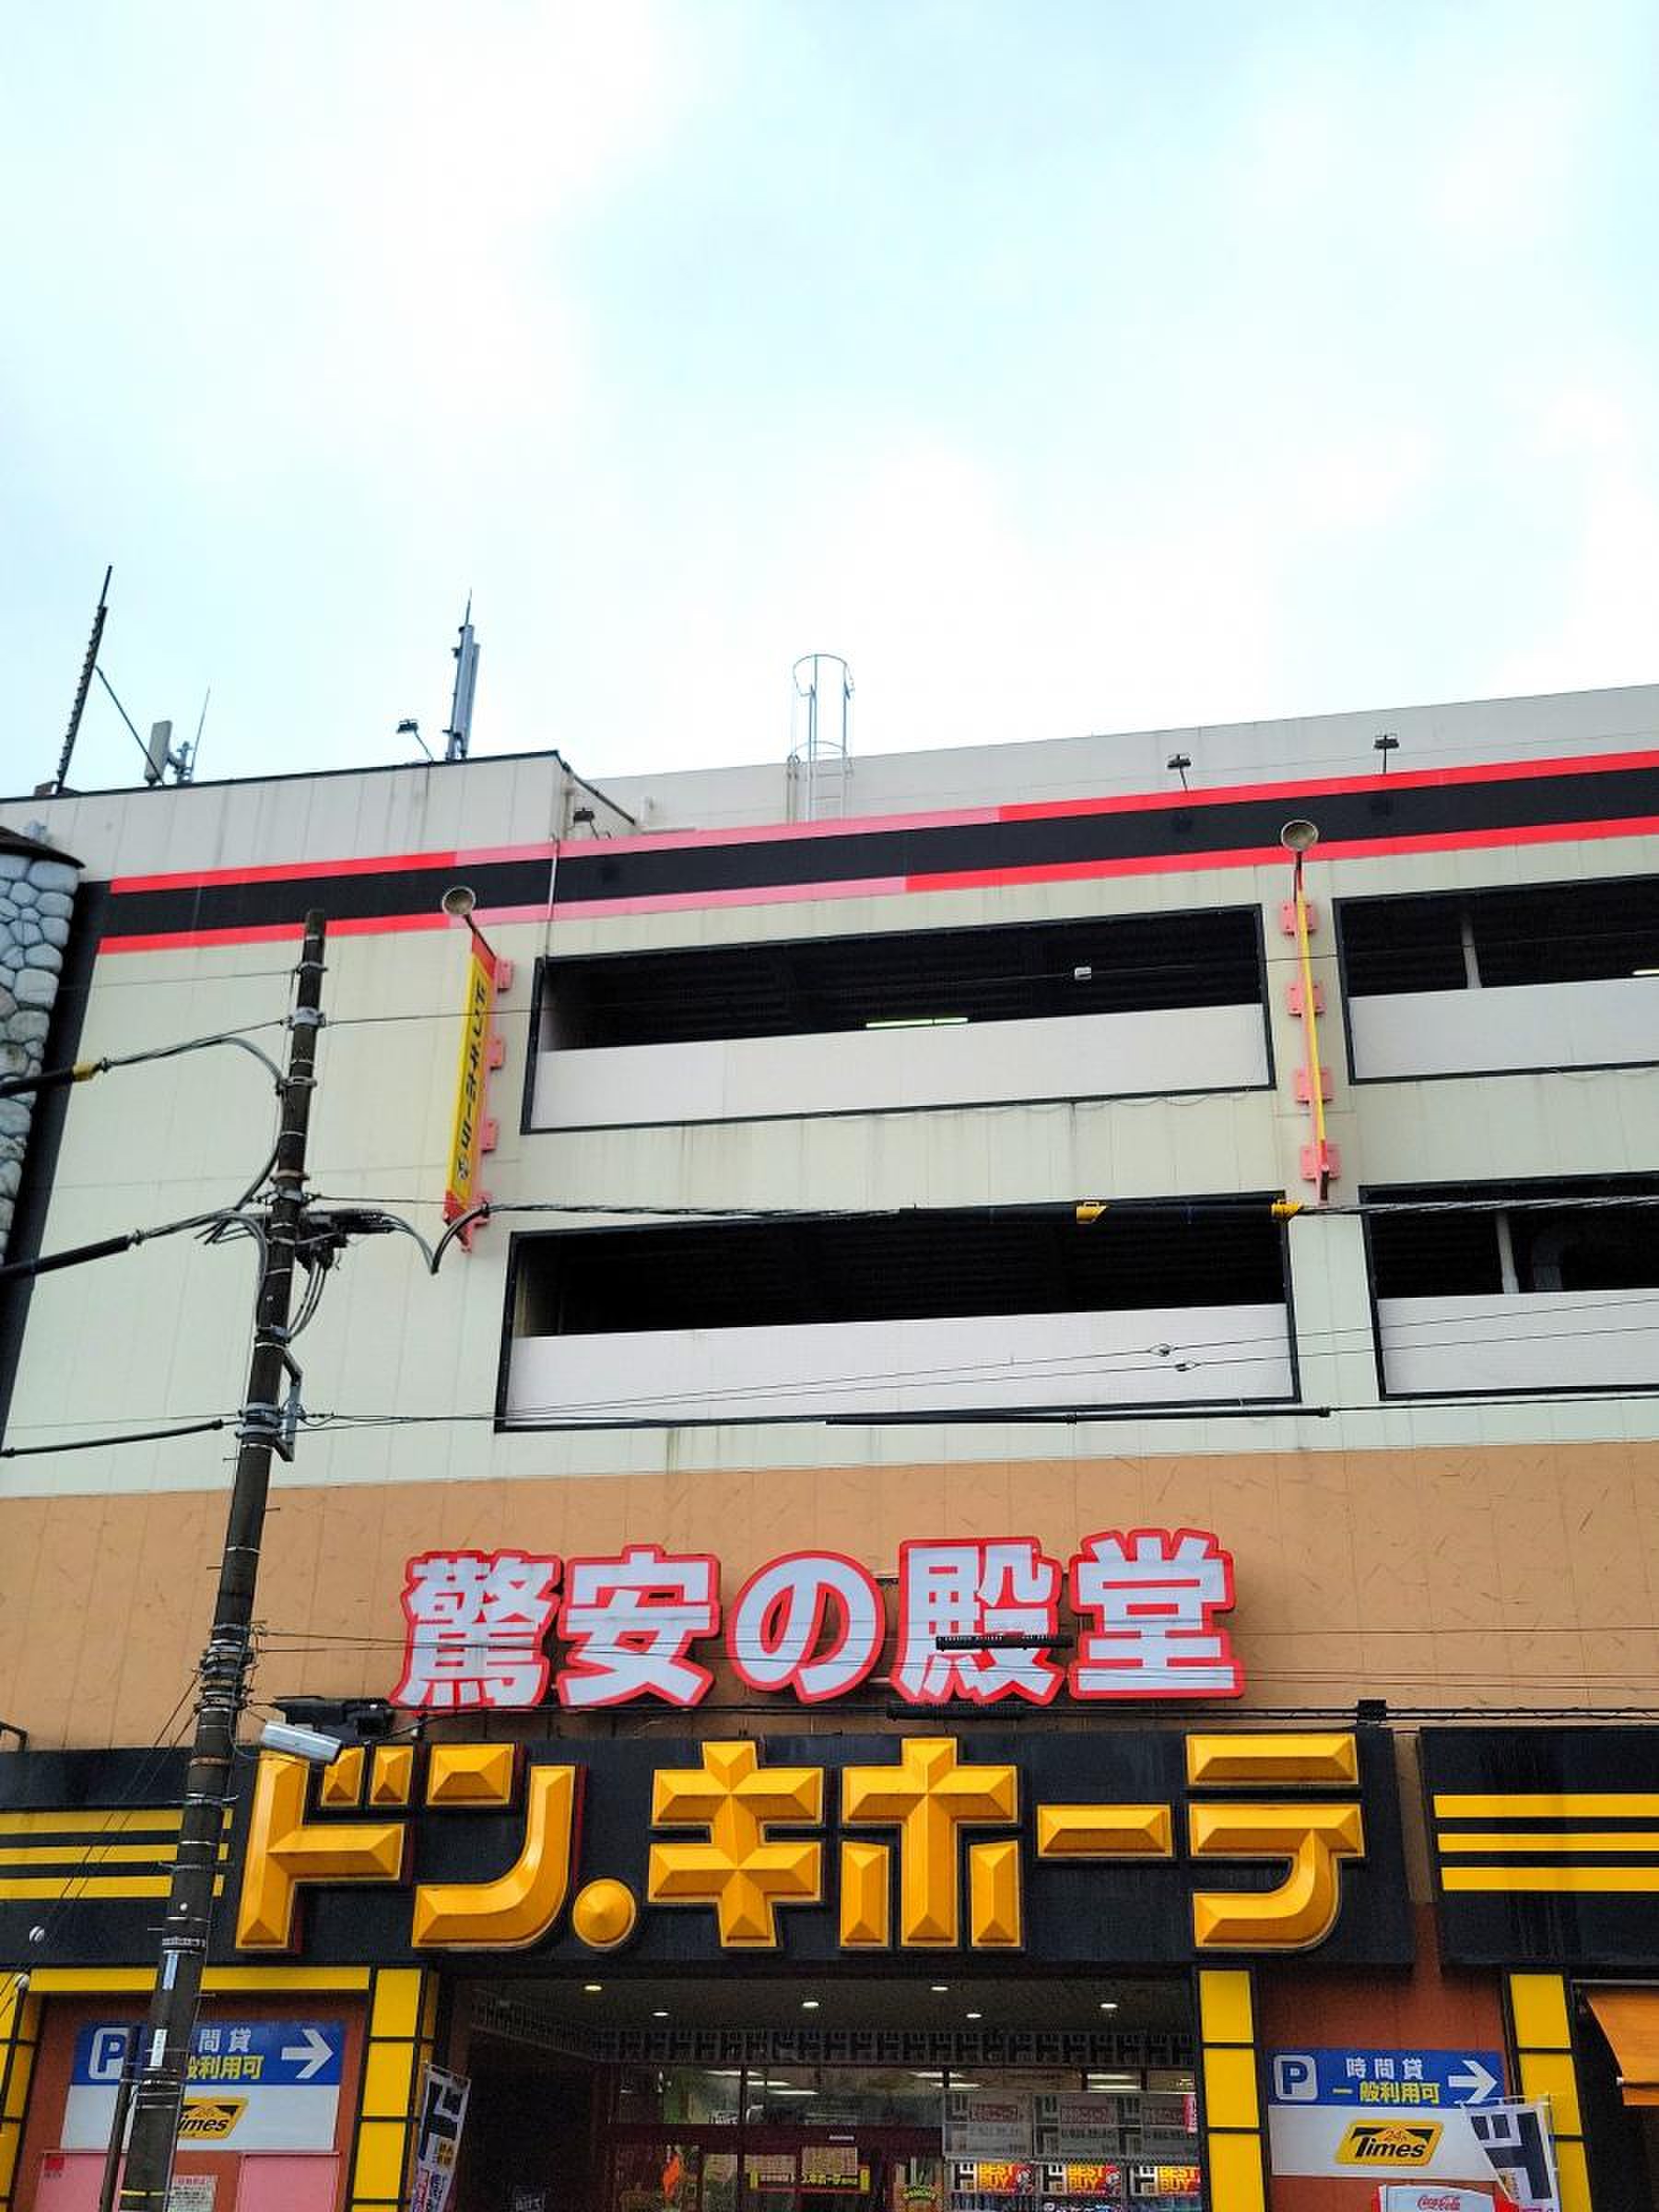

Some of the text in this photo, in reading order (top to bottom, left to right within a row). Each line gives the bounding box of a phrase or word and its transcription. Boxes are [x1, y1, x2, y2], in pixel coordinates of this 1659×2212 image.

[391, 1528, 1244, 1709] 驚安の殿堂
[197, 2027, 252, 2053] 間貸
[186, 2054, 265, 2080] 利用可
[1346, 2056, 1424, 2080] 時間貸
[1332, 2080, 1441, 2105] 一般利用可
[179, 2112, 229, 2133] imes
[1355, 2128, 1427, 2159] Times
[979, 2162, 1015, 2175] BEST
[1067, 2164, 1104, 2176] BEST
[1159, 2166, 1196, 2178] BEST
[979, 2175, 1008, 2188] BUY
[1067, 2176, 1099, 2190] BUY
[1160, 2178, 1191, 2191] BUY
